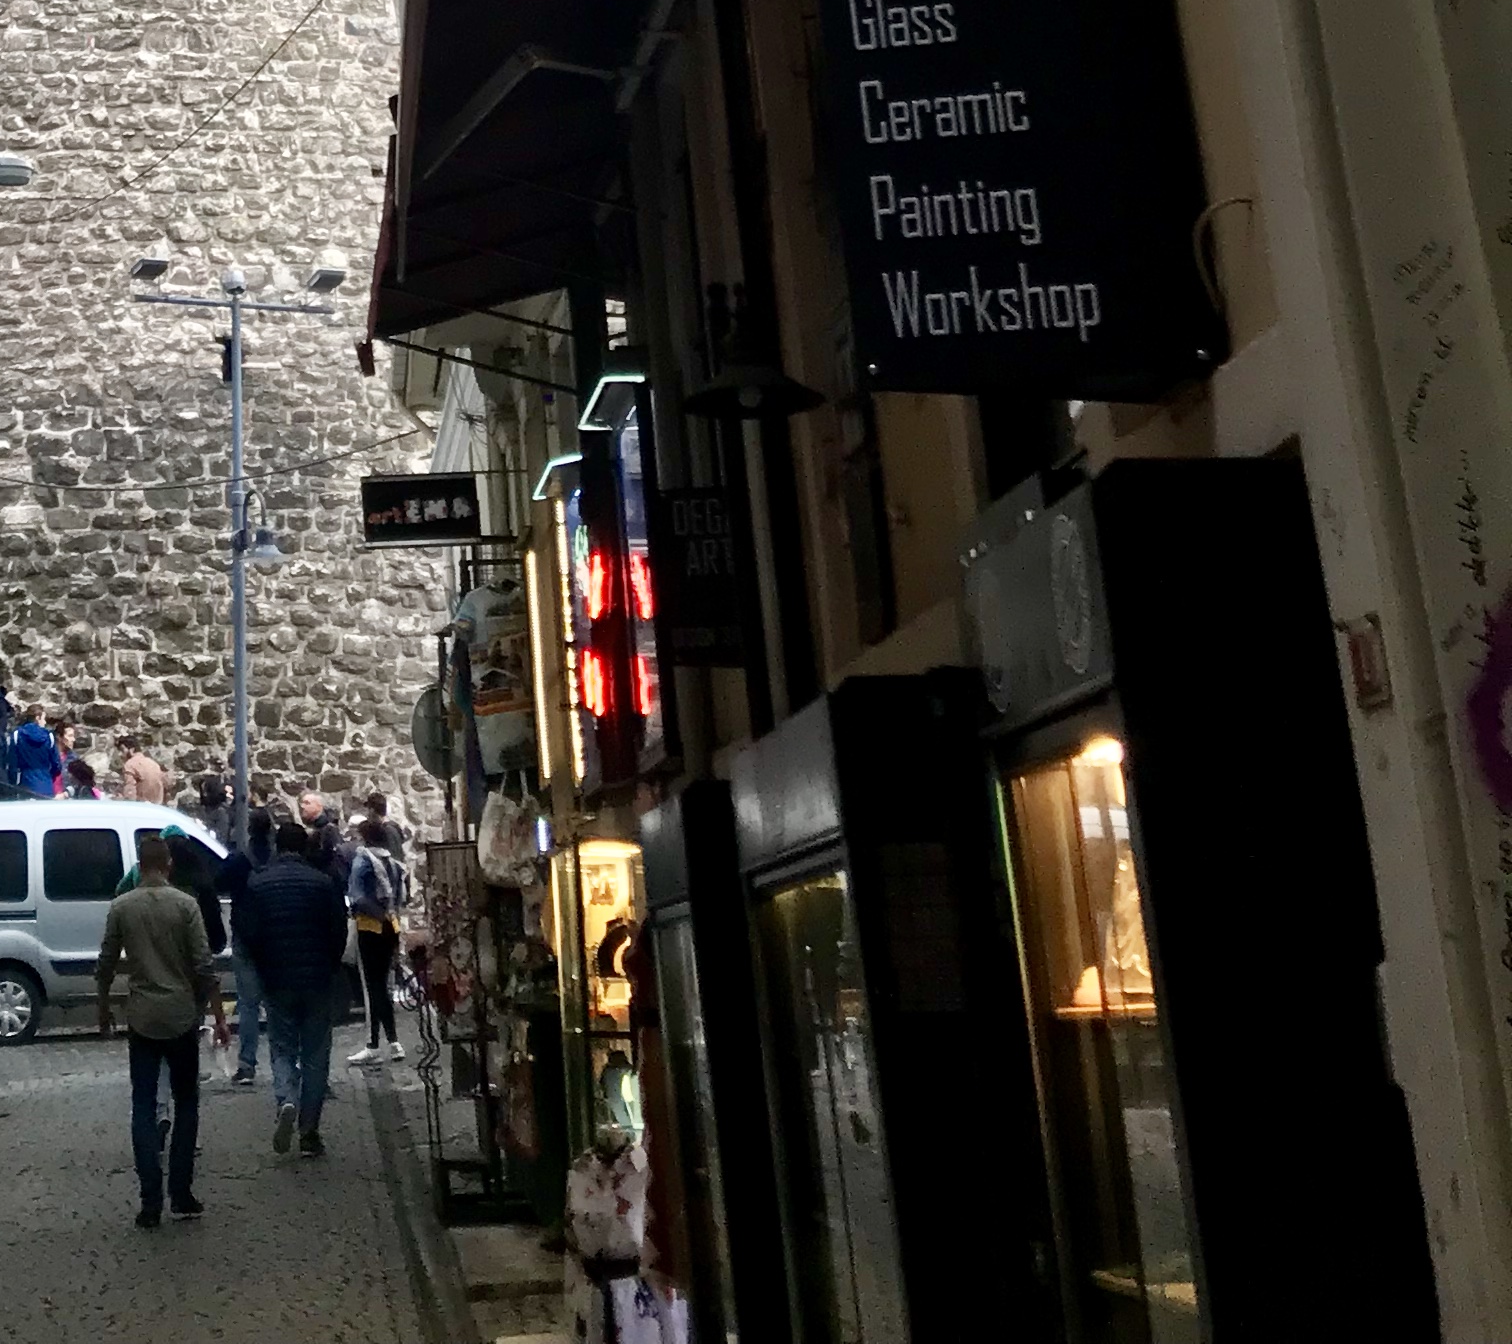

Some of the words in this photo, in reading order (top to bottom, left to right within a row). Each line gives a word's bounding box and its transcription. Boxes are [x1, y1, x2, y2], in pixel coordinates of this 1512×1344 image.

[859, 80, 1031, 144] Ceramic
[869, 175, 1043, 246] Painting
[882, 262, 1103, 342] Workshop
